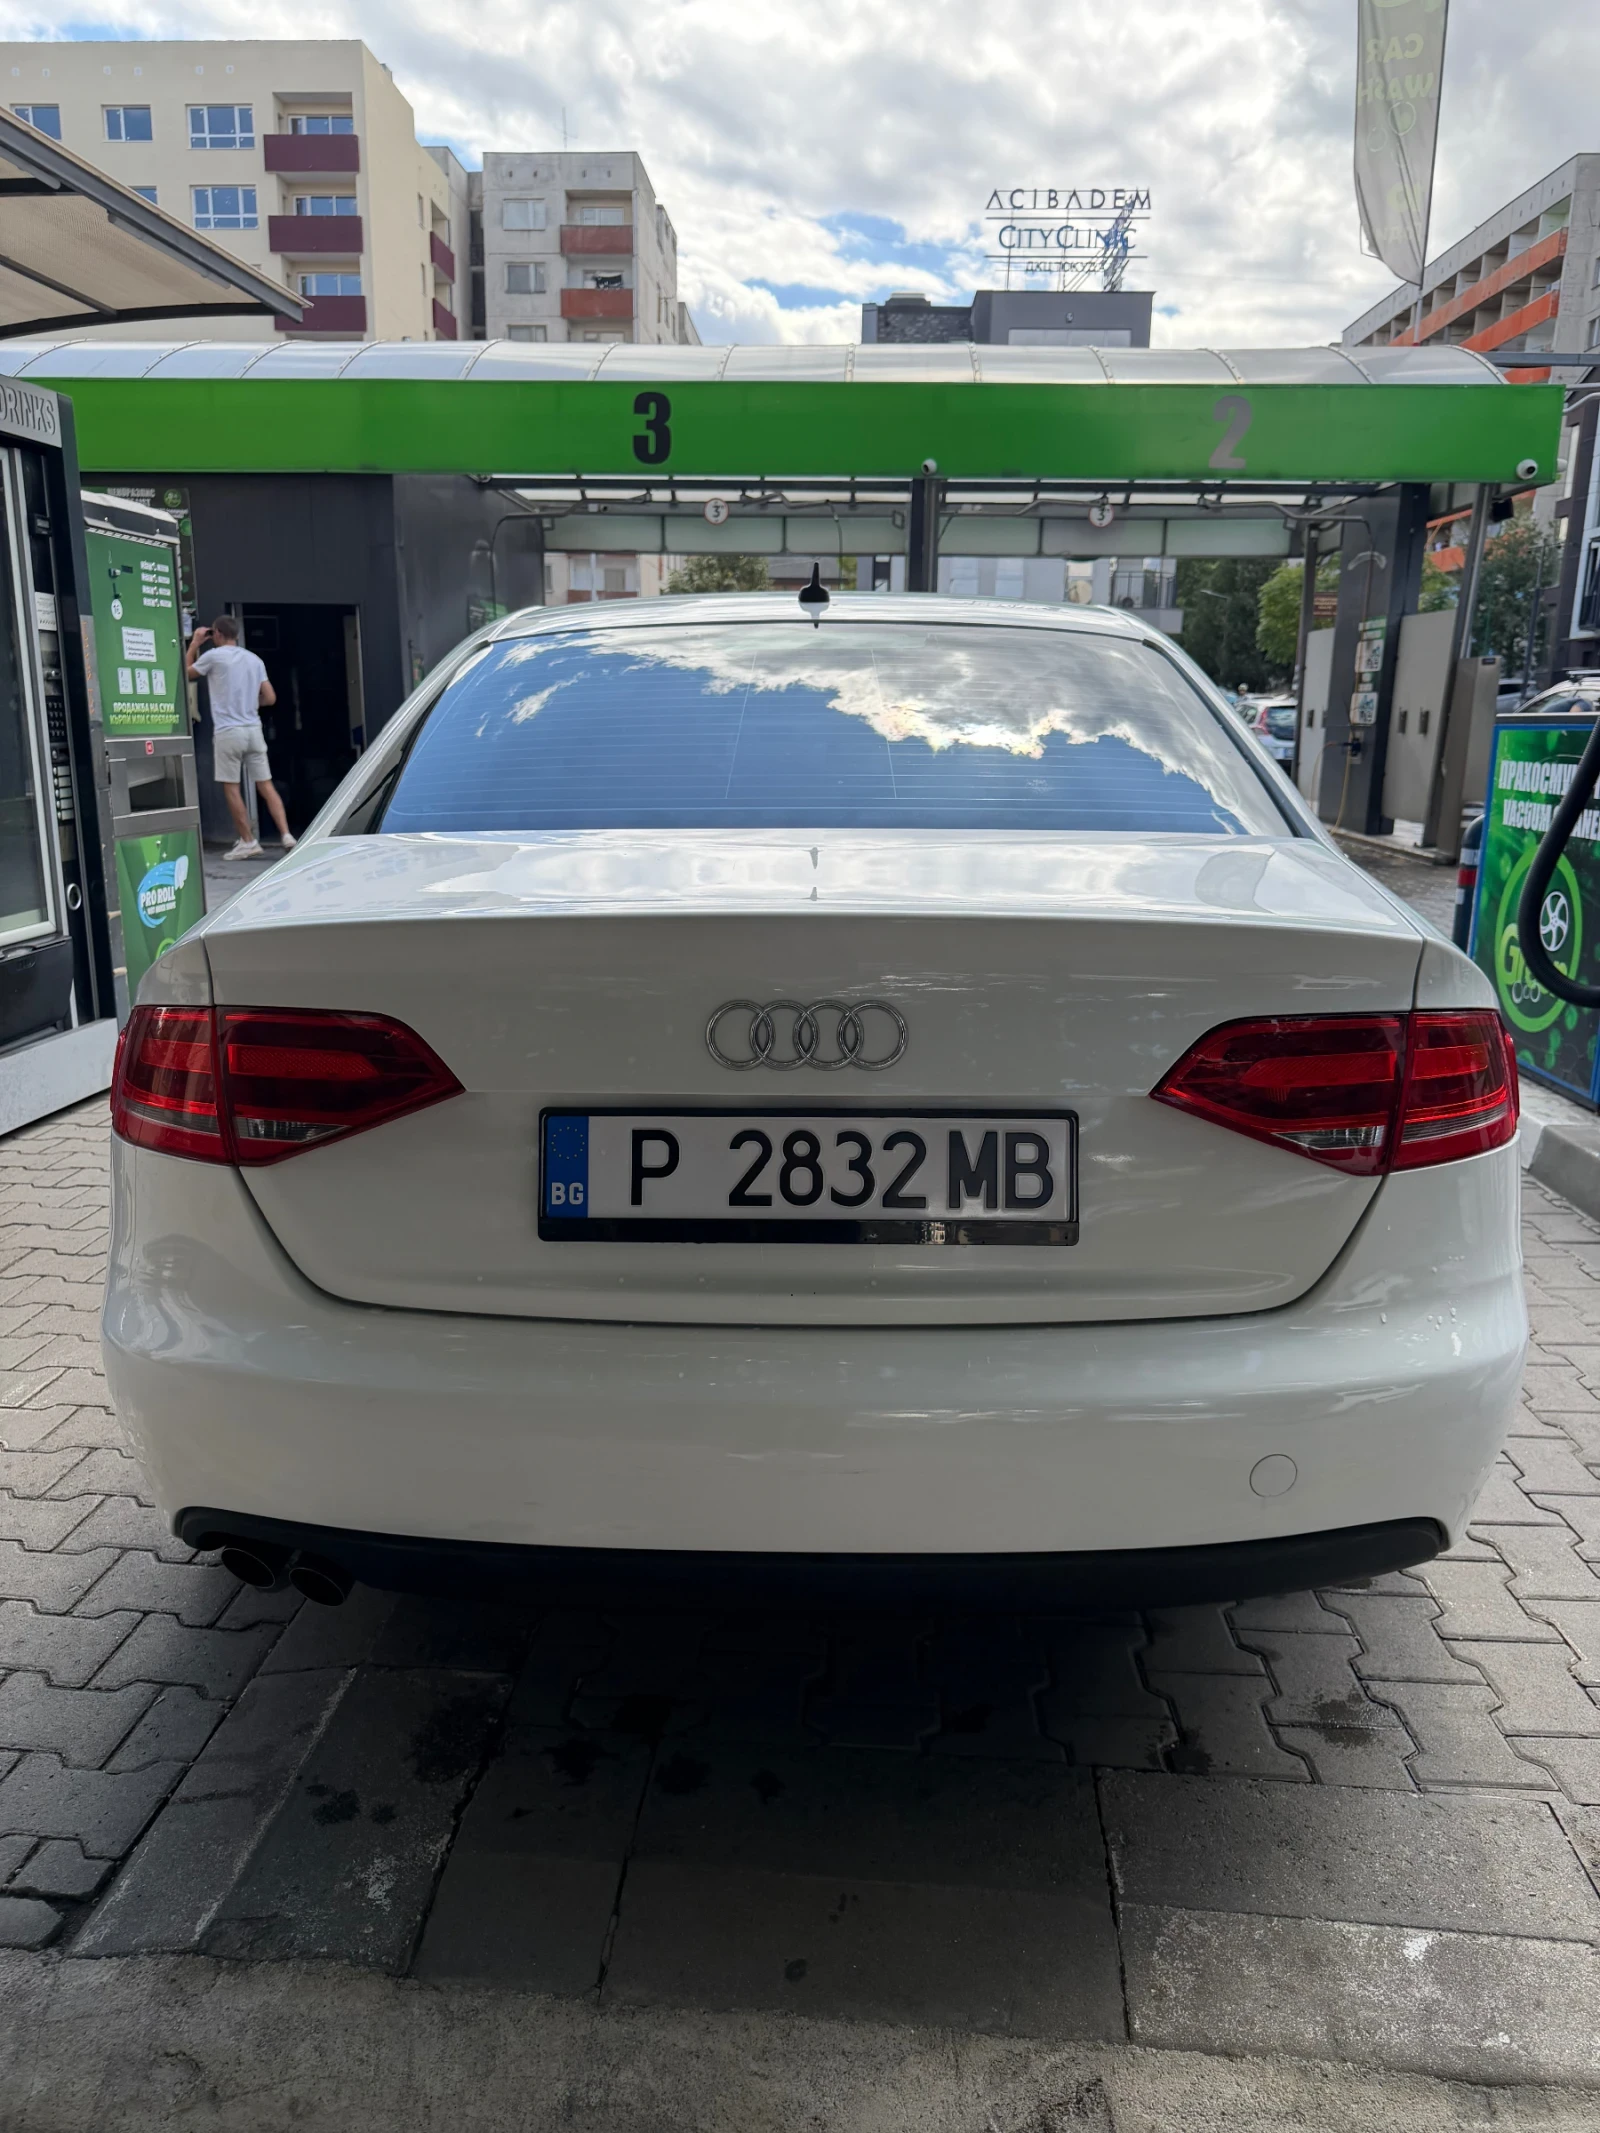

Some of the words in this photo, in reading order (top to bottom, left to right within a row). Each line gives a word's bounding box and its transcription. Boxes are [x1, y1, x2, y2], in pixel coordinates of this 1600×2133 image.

[986, 188, 1151, 210] ACIBADEM
[633, 391, 672, 465] 3
[1208, 395, 1252, 469] 2
[1502, 799, 1553, 833] VACUUM
[141, 890, 157, 908] PRO
[157, 886, 176, 904] ROLL
[630, 1129, 680, 1206] P
[728, 1130, 927, 1209] 2832
[948, 1131, 1054, 1209] MB
[551, 1182, 584, 1205] BG
